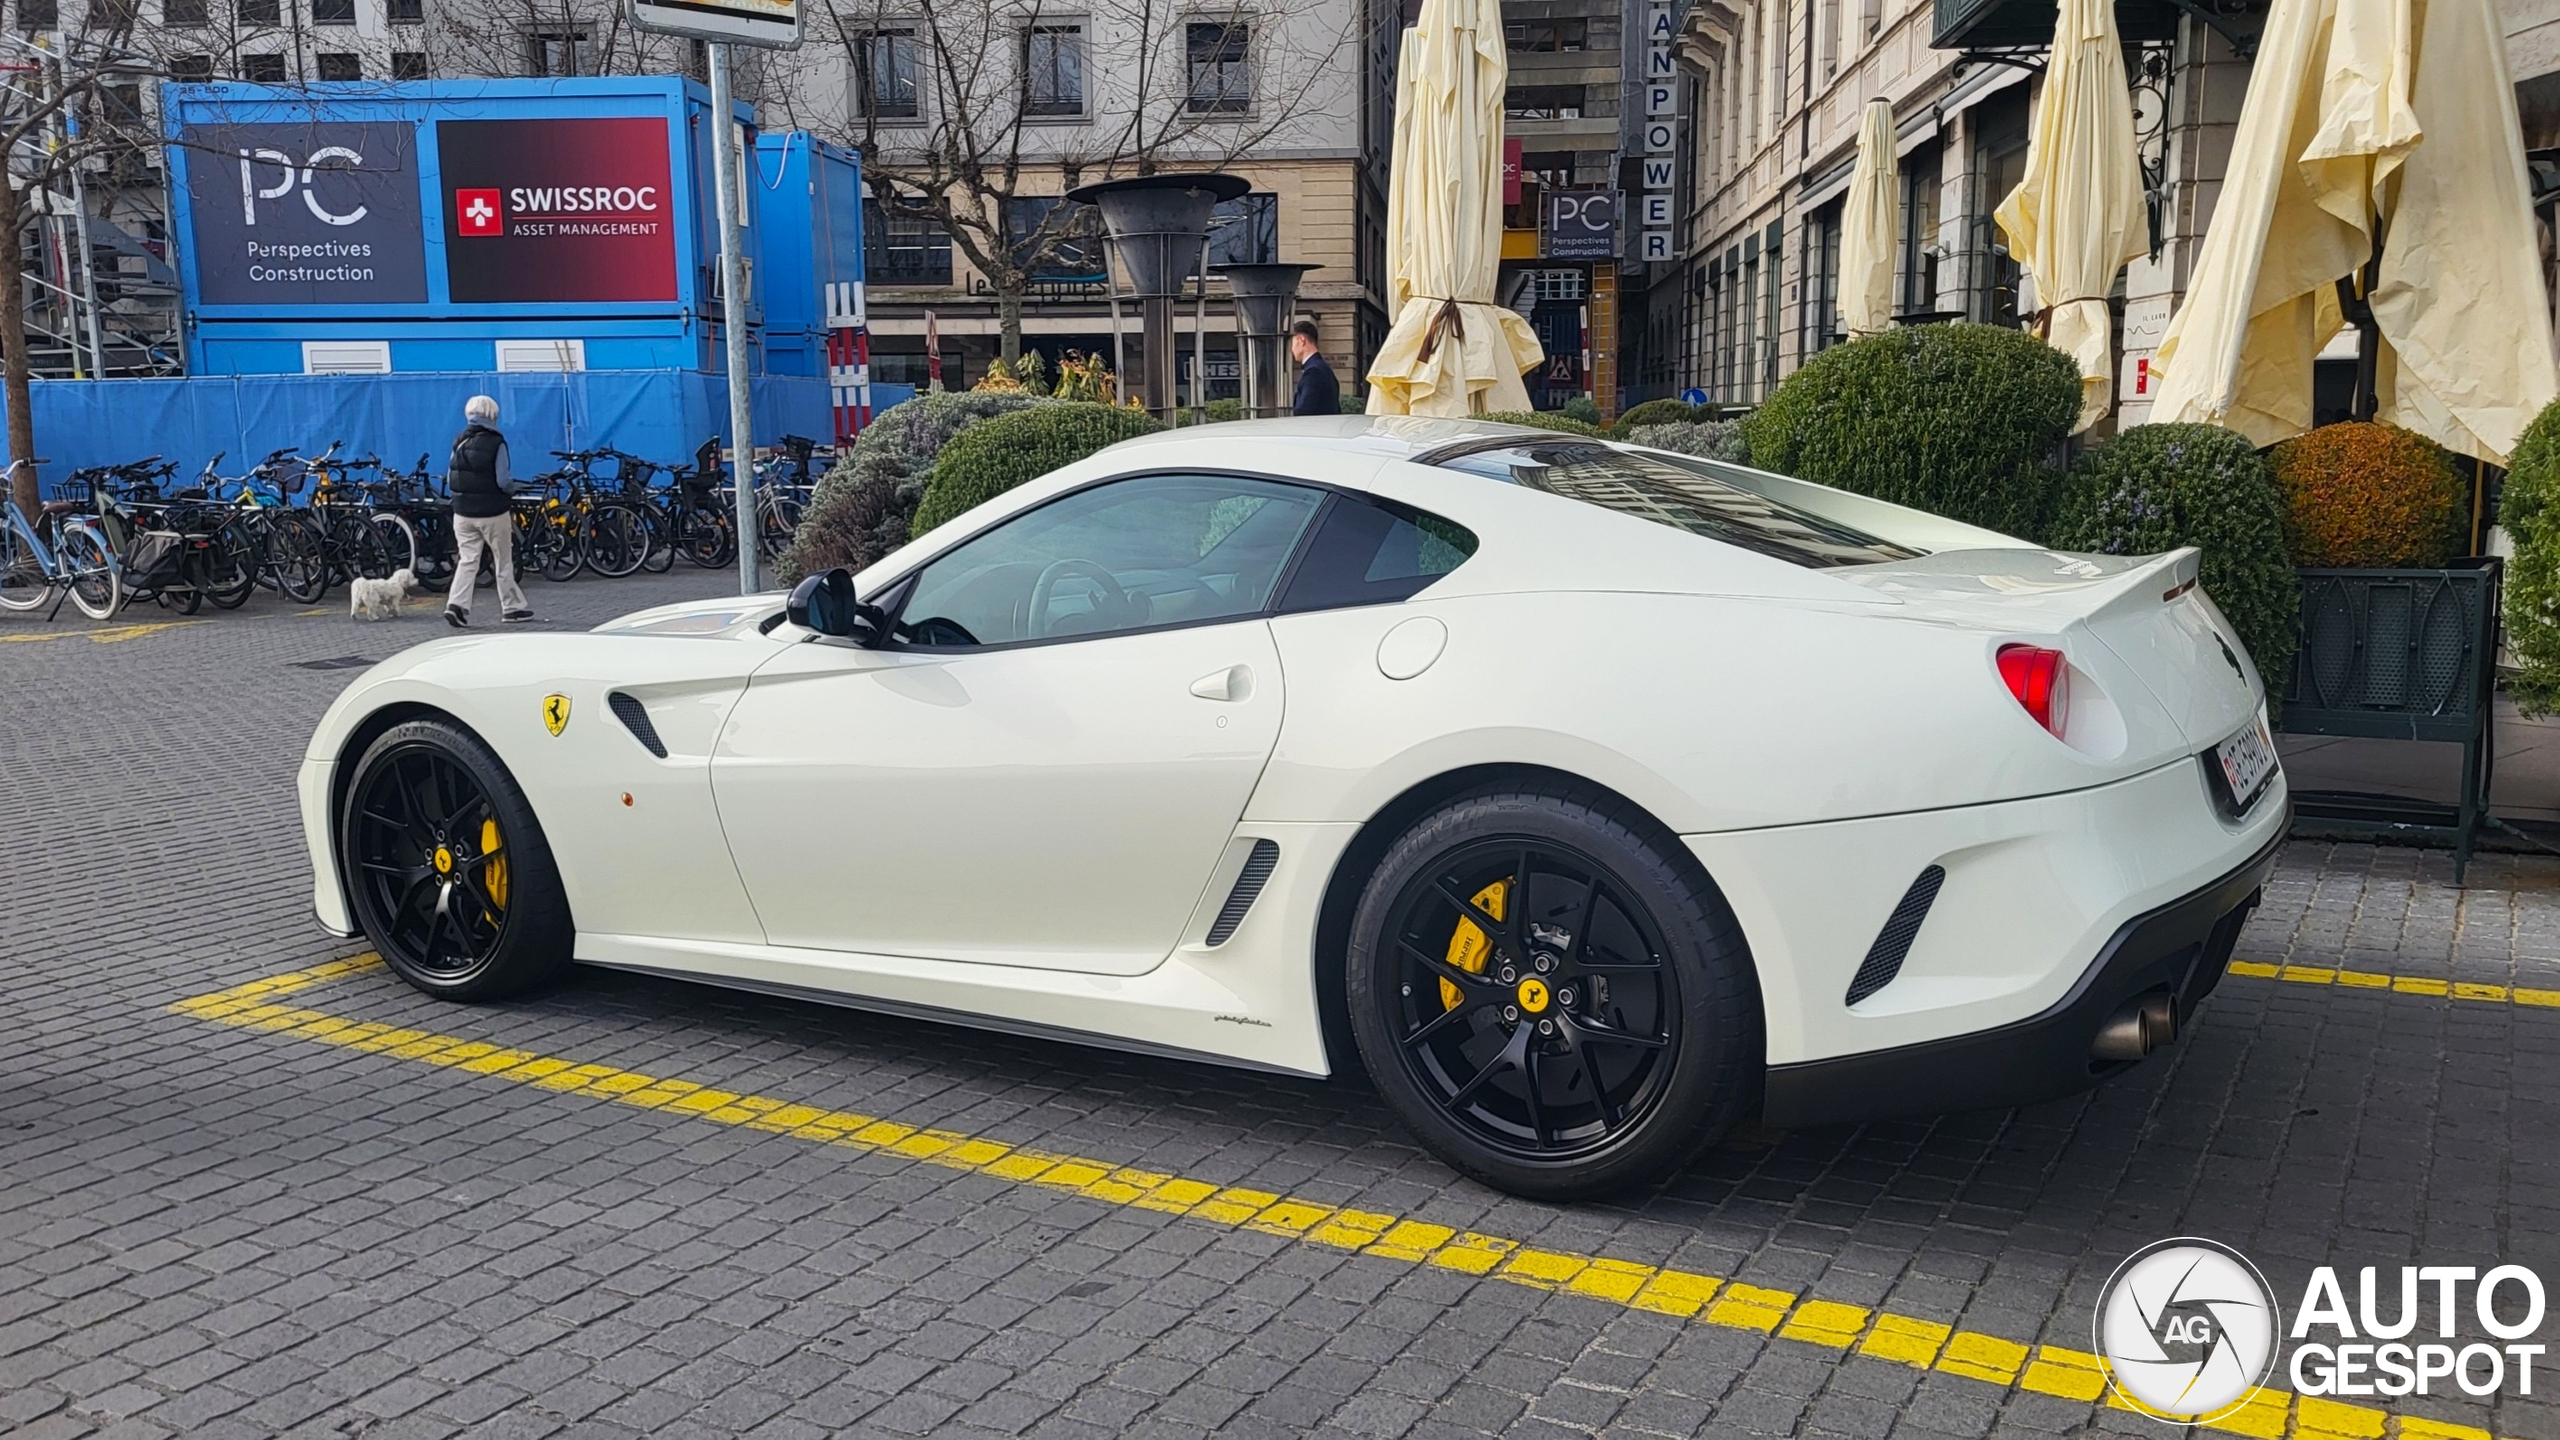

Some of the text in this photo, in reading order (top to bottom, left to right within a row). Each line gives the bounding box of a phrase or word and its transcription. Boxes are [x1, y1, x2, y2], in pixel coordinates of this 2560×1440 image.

[239, 146, 368, 226] PC
[510, 187, 658, 212] SWISSROC
[1553, 195, 1611, 231] PC
[513, 223, 659, 236] ASSET MANAGEMENT
[247, 240, 372, 262] Perspectives
[1552, 237, 1610, 247] Perspectives
[1552, 247, 1610, 256] Construction
[249, 264, 374, 282] Construction
